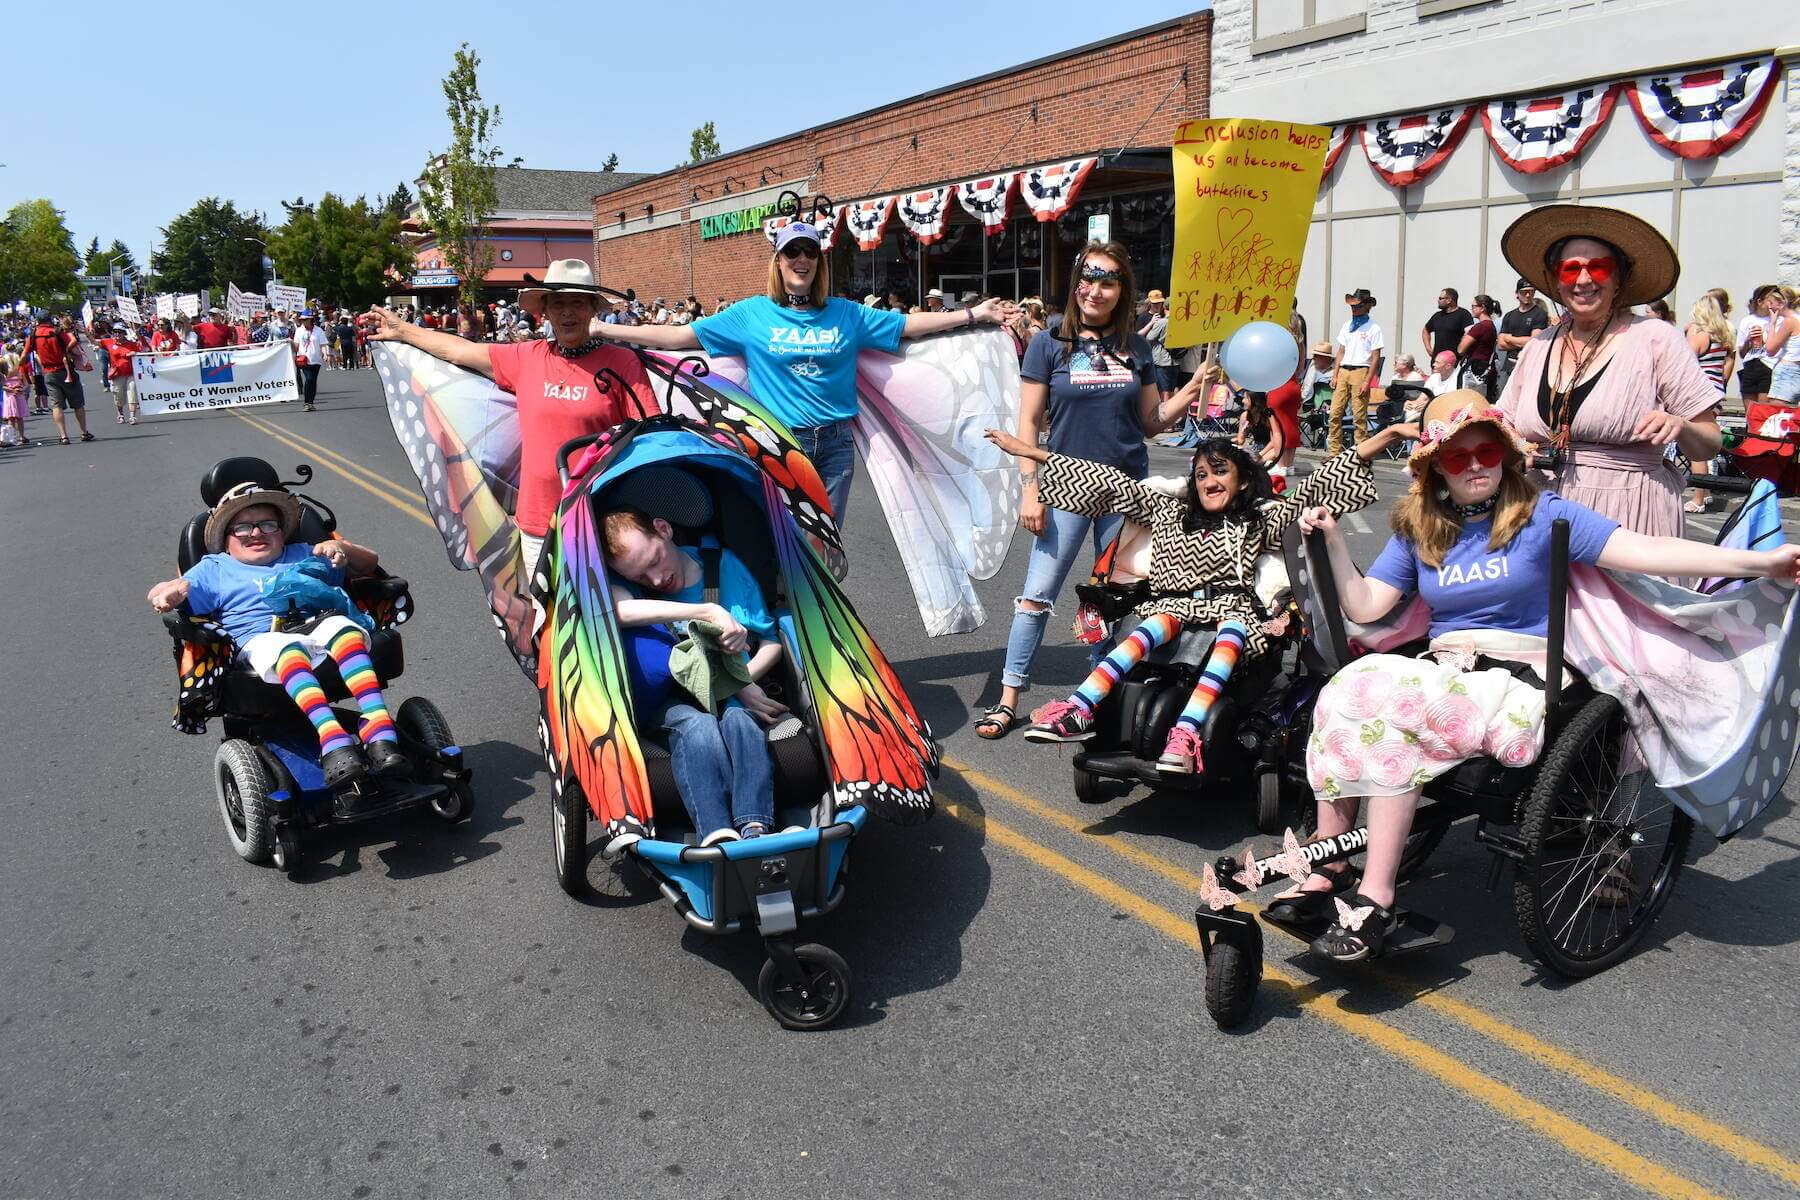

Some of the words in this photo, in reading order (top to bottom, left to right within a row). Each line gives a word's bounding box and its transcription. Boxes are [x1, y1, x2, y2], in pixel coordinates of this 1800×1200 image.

[1175, 122, 1279, 145] Inclusion
[1288, 124, 1325, 149] helps
[1194, 154, 1215, 168] us
[1226, 155, 1238, 166] all
[1245, 150, 1304, 172] become
[1196, 177, 1268, 201] butterflies
[768, 326, 840, 345] YAAS!
[140, 391, 186, 402] League
[189, 387, 203, 397] Of
[207, 385, 251, 396] Women
[255, 379, 295, 390] Voters
[168, 401, 180, 411] of
[184, 399, 205, 409] the
[209, 398, 231, 407] San
[235, 393, 272, 404] Juans
[1438, 556, 1509, 587] YAAS!
[1338, 828, 1369, 852] CHA
